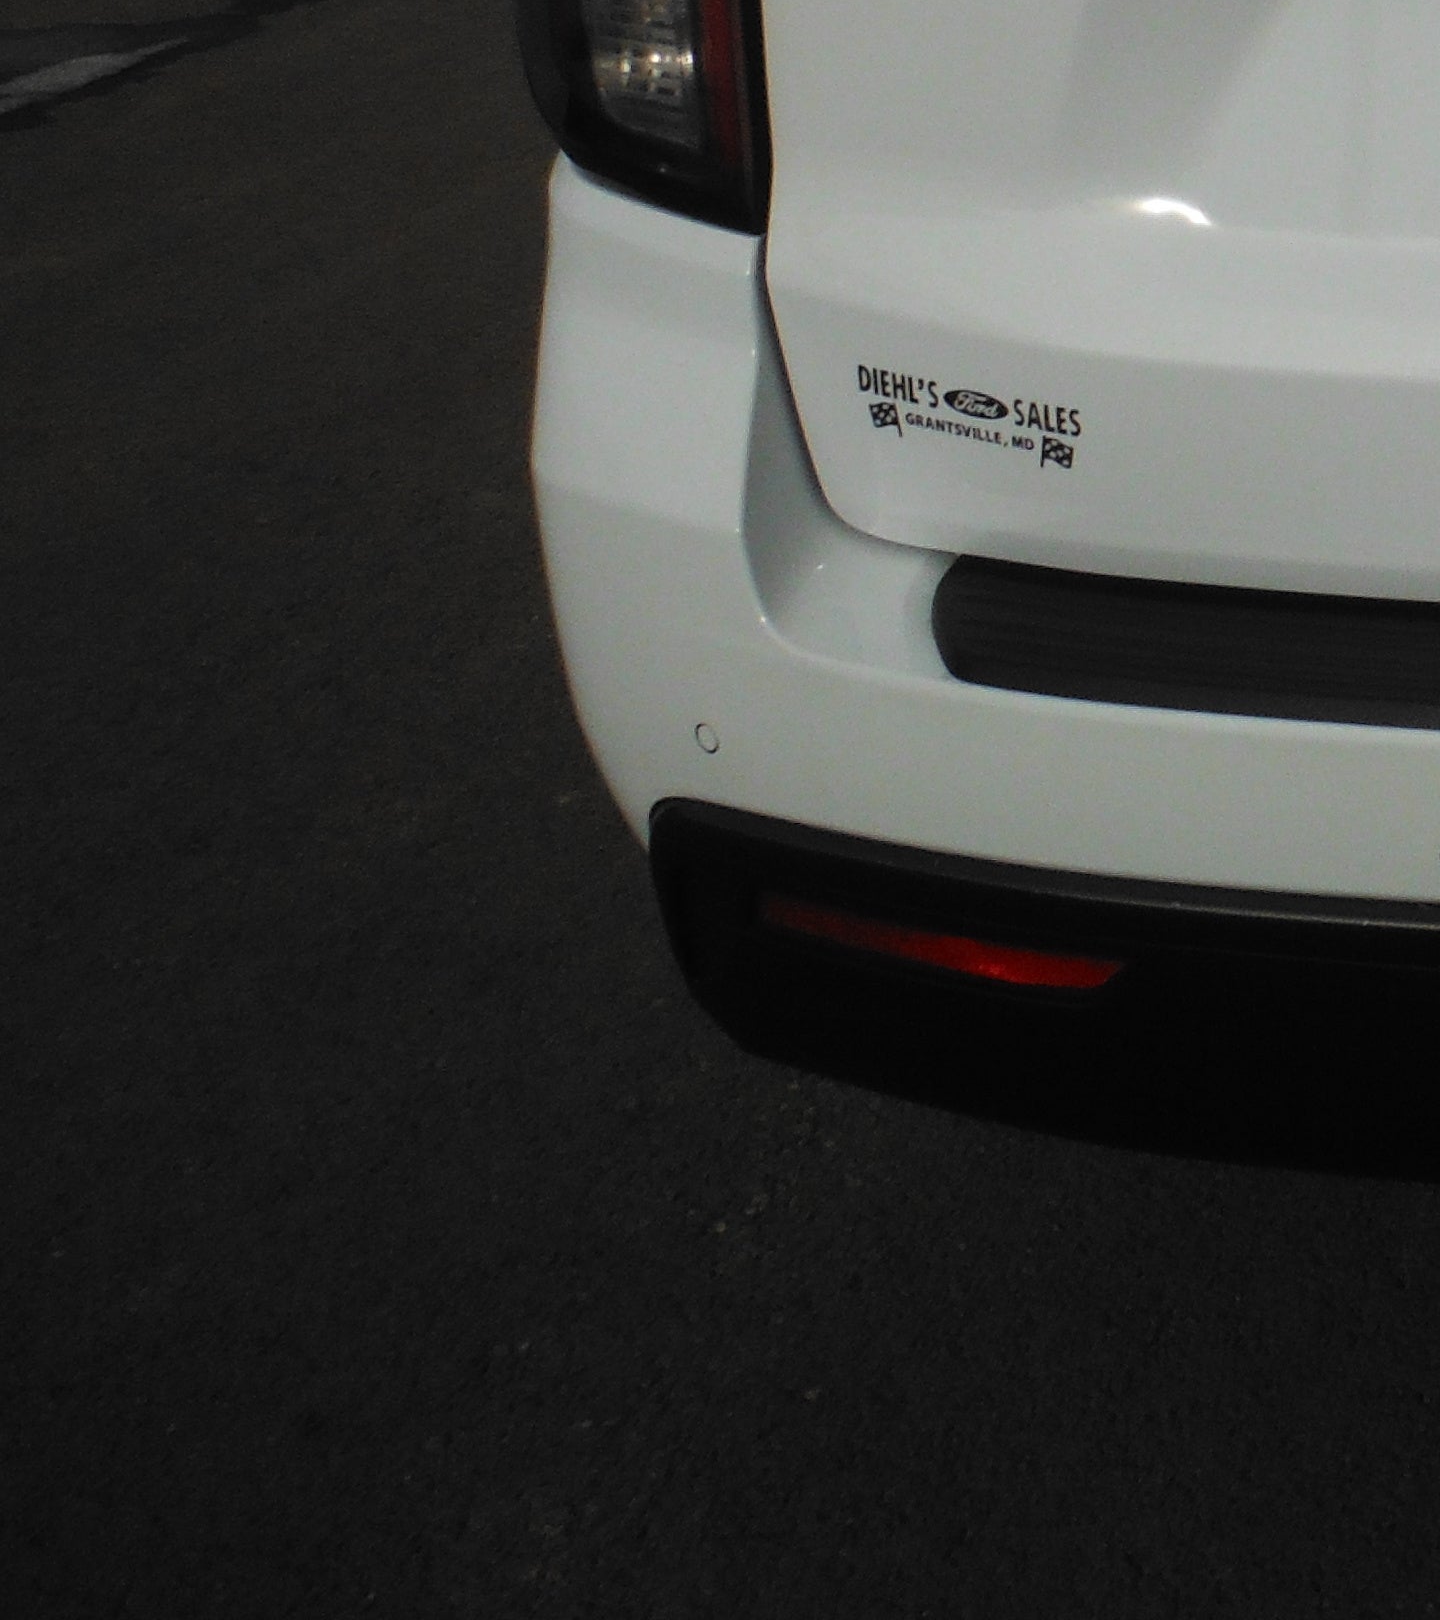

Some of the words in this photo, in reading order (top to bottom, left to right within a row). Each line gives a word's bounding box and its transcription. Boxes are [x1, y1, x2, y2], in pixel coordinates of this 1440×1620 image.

[857, 364, 940, 409] DIEHL'S
[951, 390, 1001, 419] Ford
[1013, 398, 1081, 437] SALES
[905, 412, 1009, 448] GRANTSVILLE,
[1011, 435, 1035, 451] MD
